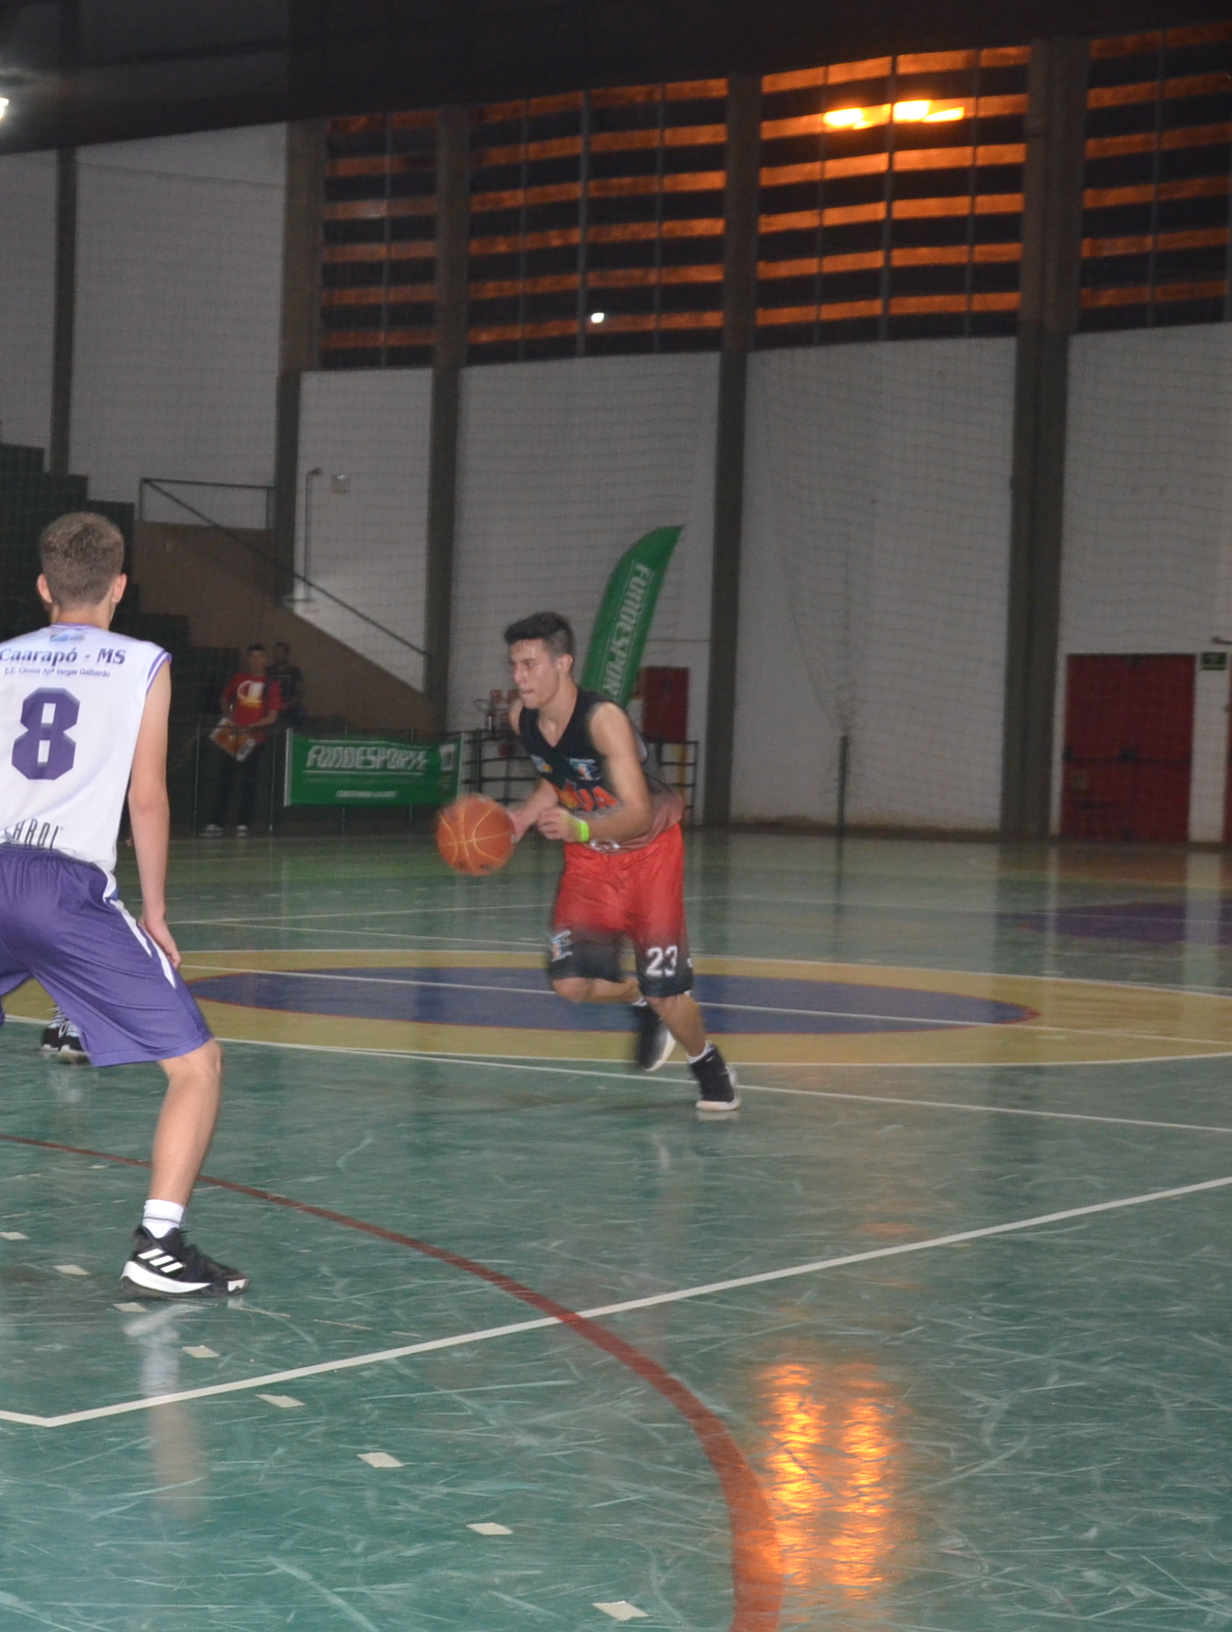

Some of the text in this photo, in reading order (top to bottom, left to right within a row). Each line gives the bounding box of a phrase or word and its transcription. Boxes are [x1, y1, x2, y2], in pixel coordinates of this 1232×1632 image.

[97, 648, 127, 665] MS
[11, 686, 81, 781] 8
[645, 945, 679, 977] 23
